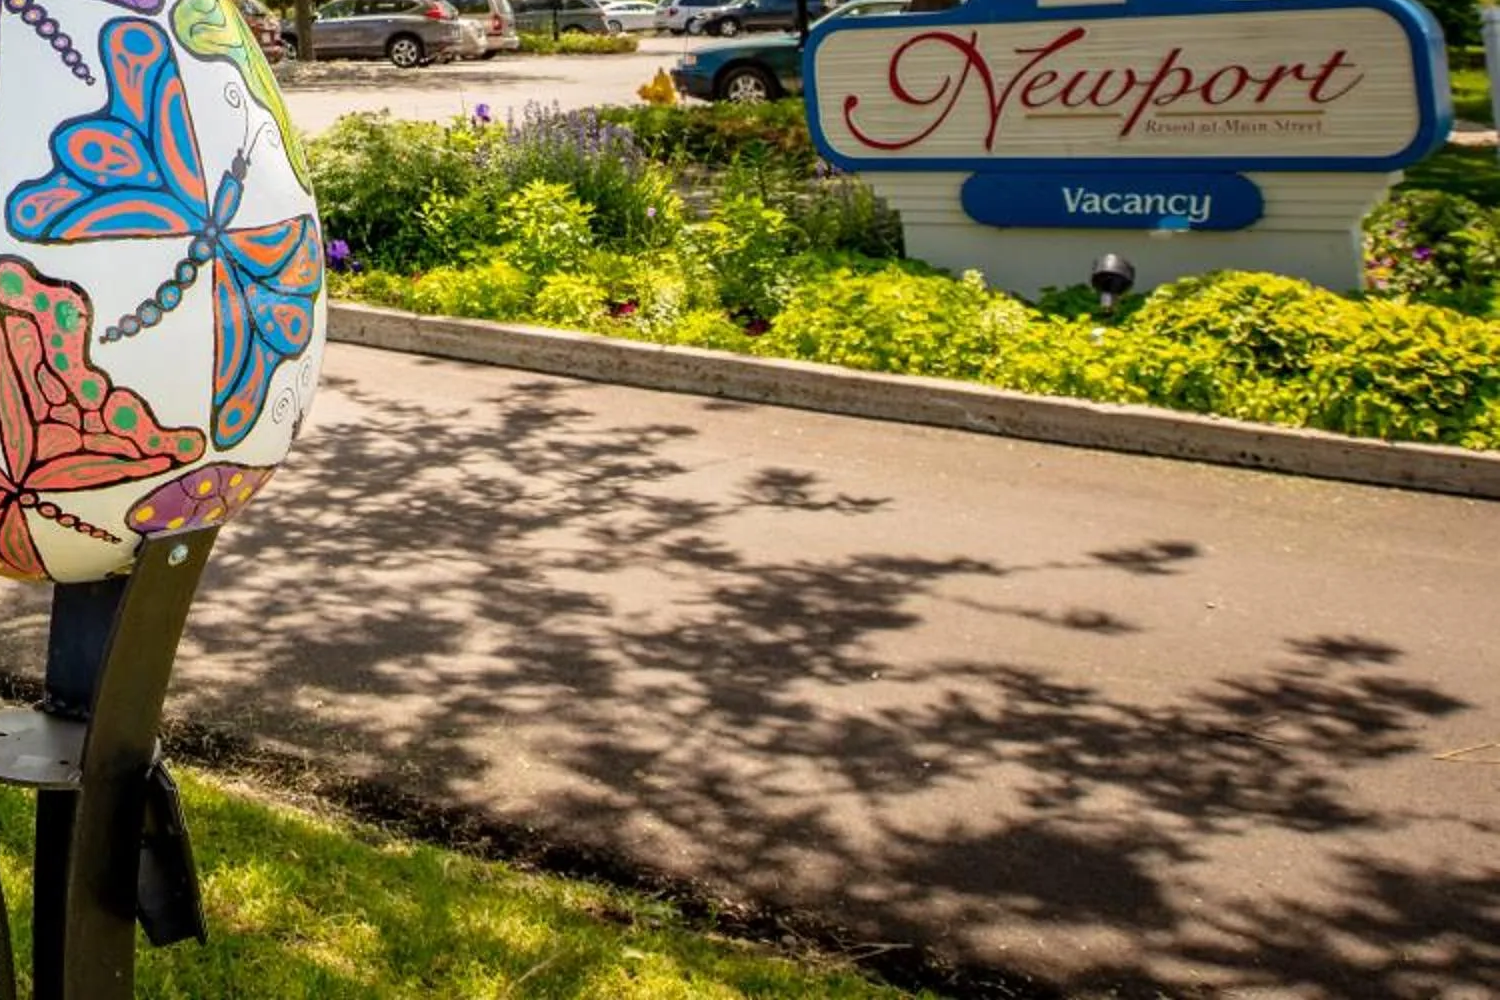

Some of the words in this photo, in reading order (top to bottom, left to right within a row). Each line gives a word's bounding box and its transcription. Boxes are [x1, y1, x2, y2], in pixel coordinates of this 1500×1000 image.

[844, 27, 1364, 151] Newport
[1275, 119, 1323, 133] Street
[1062, 187, 1211, 222] Vacancy
